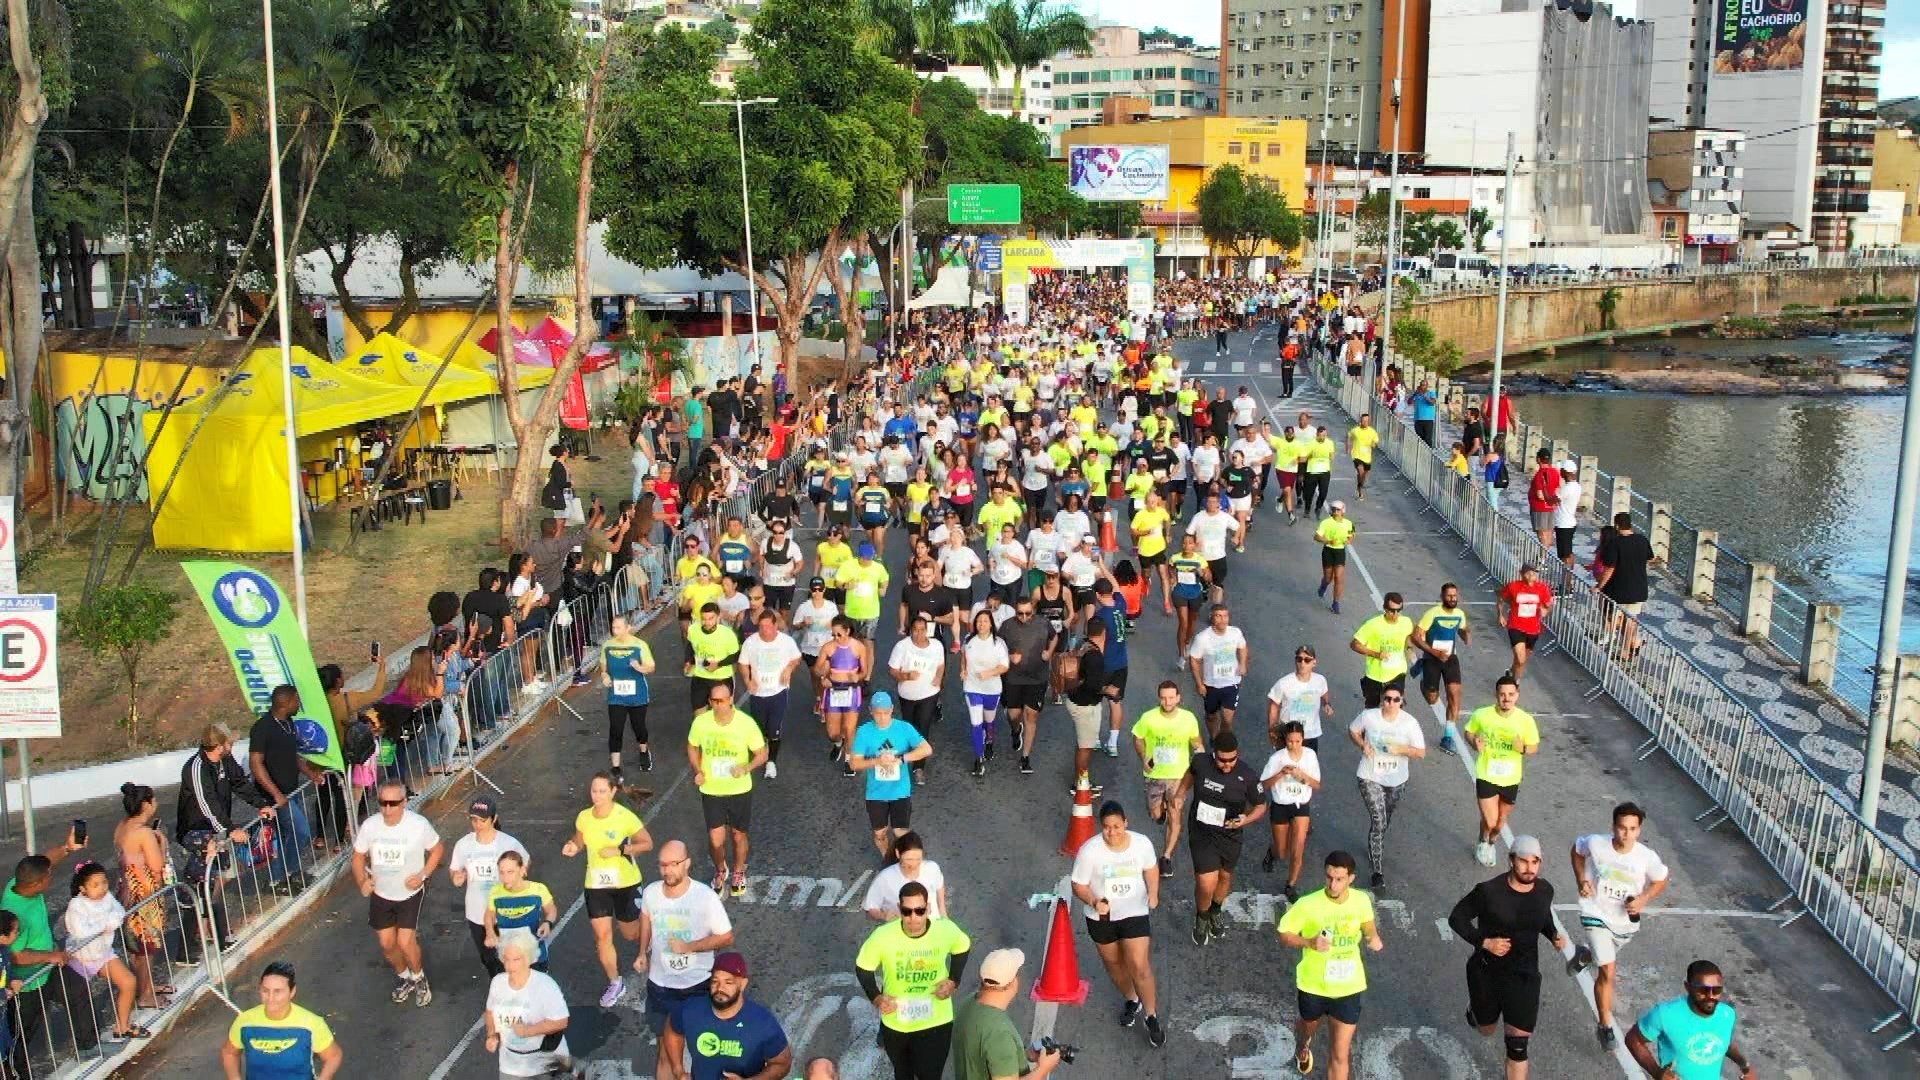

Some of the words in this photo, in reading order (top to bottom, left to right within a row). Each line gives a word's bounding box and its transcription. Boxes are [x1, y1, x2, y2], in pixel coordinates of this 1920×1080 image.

[1741, 0, 1763, 15] EU
[1740, 12, 1802, 28] CACHOEIRO
[1005, 247, 1046, 257] LARGADA
[2, 632, 25, 669] E
[896, 969, 938, 984] PEDRO
